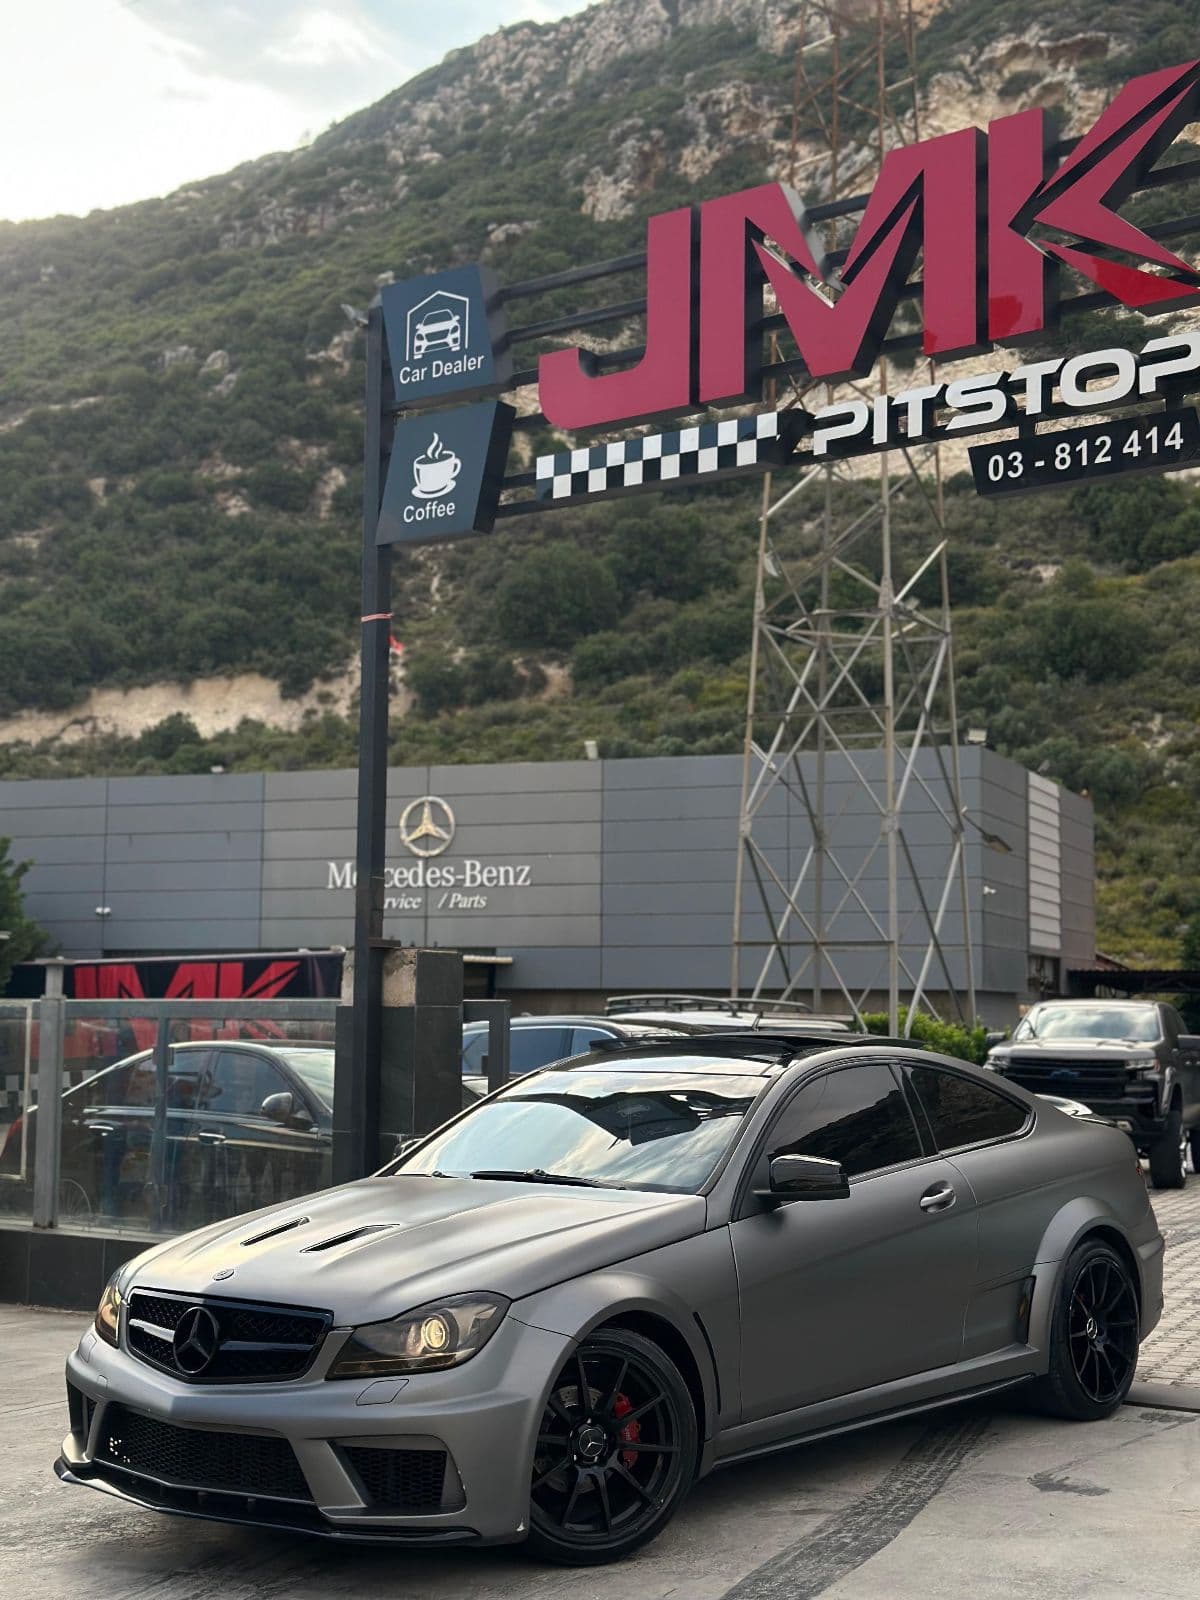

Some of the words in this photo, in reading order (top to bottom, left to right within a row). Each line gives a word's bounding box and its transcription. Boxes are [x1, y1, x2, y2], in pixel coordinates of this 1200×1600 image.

[538, 59, 1200, 430] JMK
[399, 367, 427, 384] Car
[432, 355, 484, 378] Dealer
[813, 331, 1200, 456] PITSTOP
[988, 453, 1023, 482] 03
[1034, 458, 1044, 467] -
[1054, 435, 1112, 471] 812
[1122, 422, 1184, 457] 414
[403, 501, 456, 523] Coffee
[327, 859, 531, 889] Mcedes-Benz
[383, 892, 422, 909] rvice
[449, 892, 487, 909] Parts
